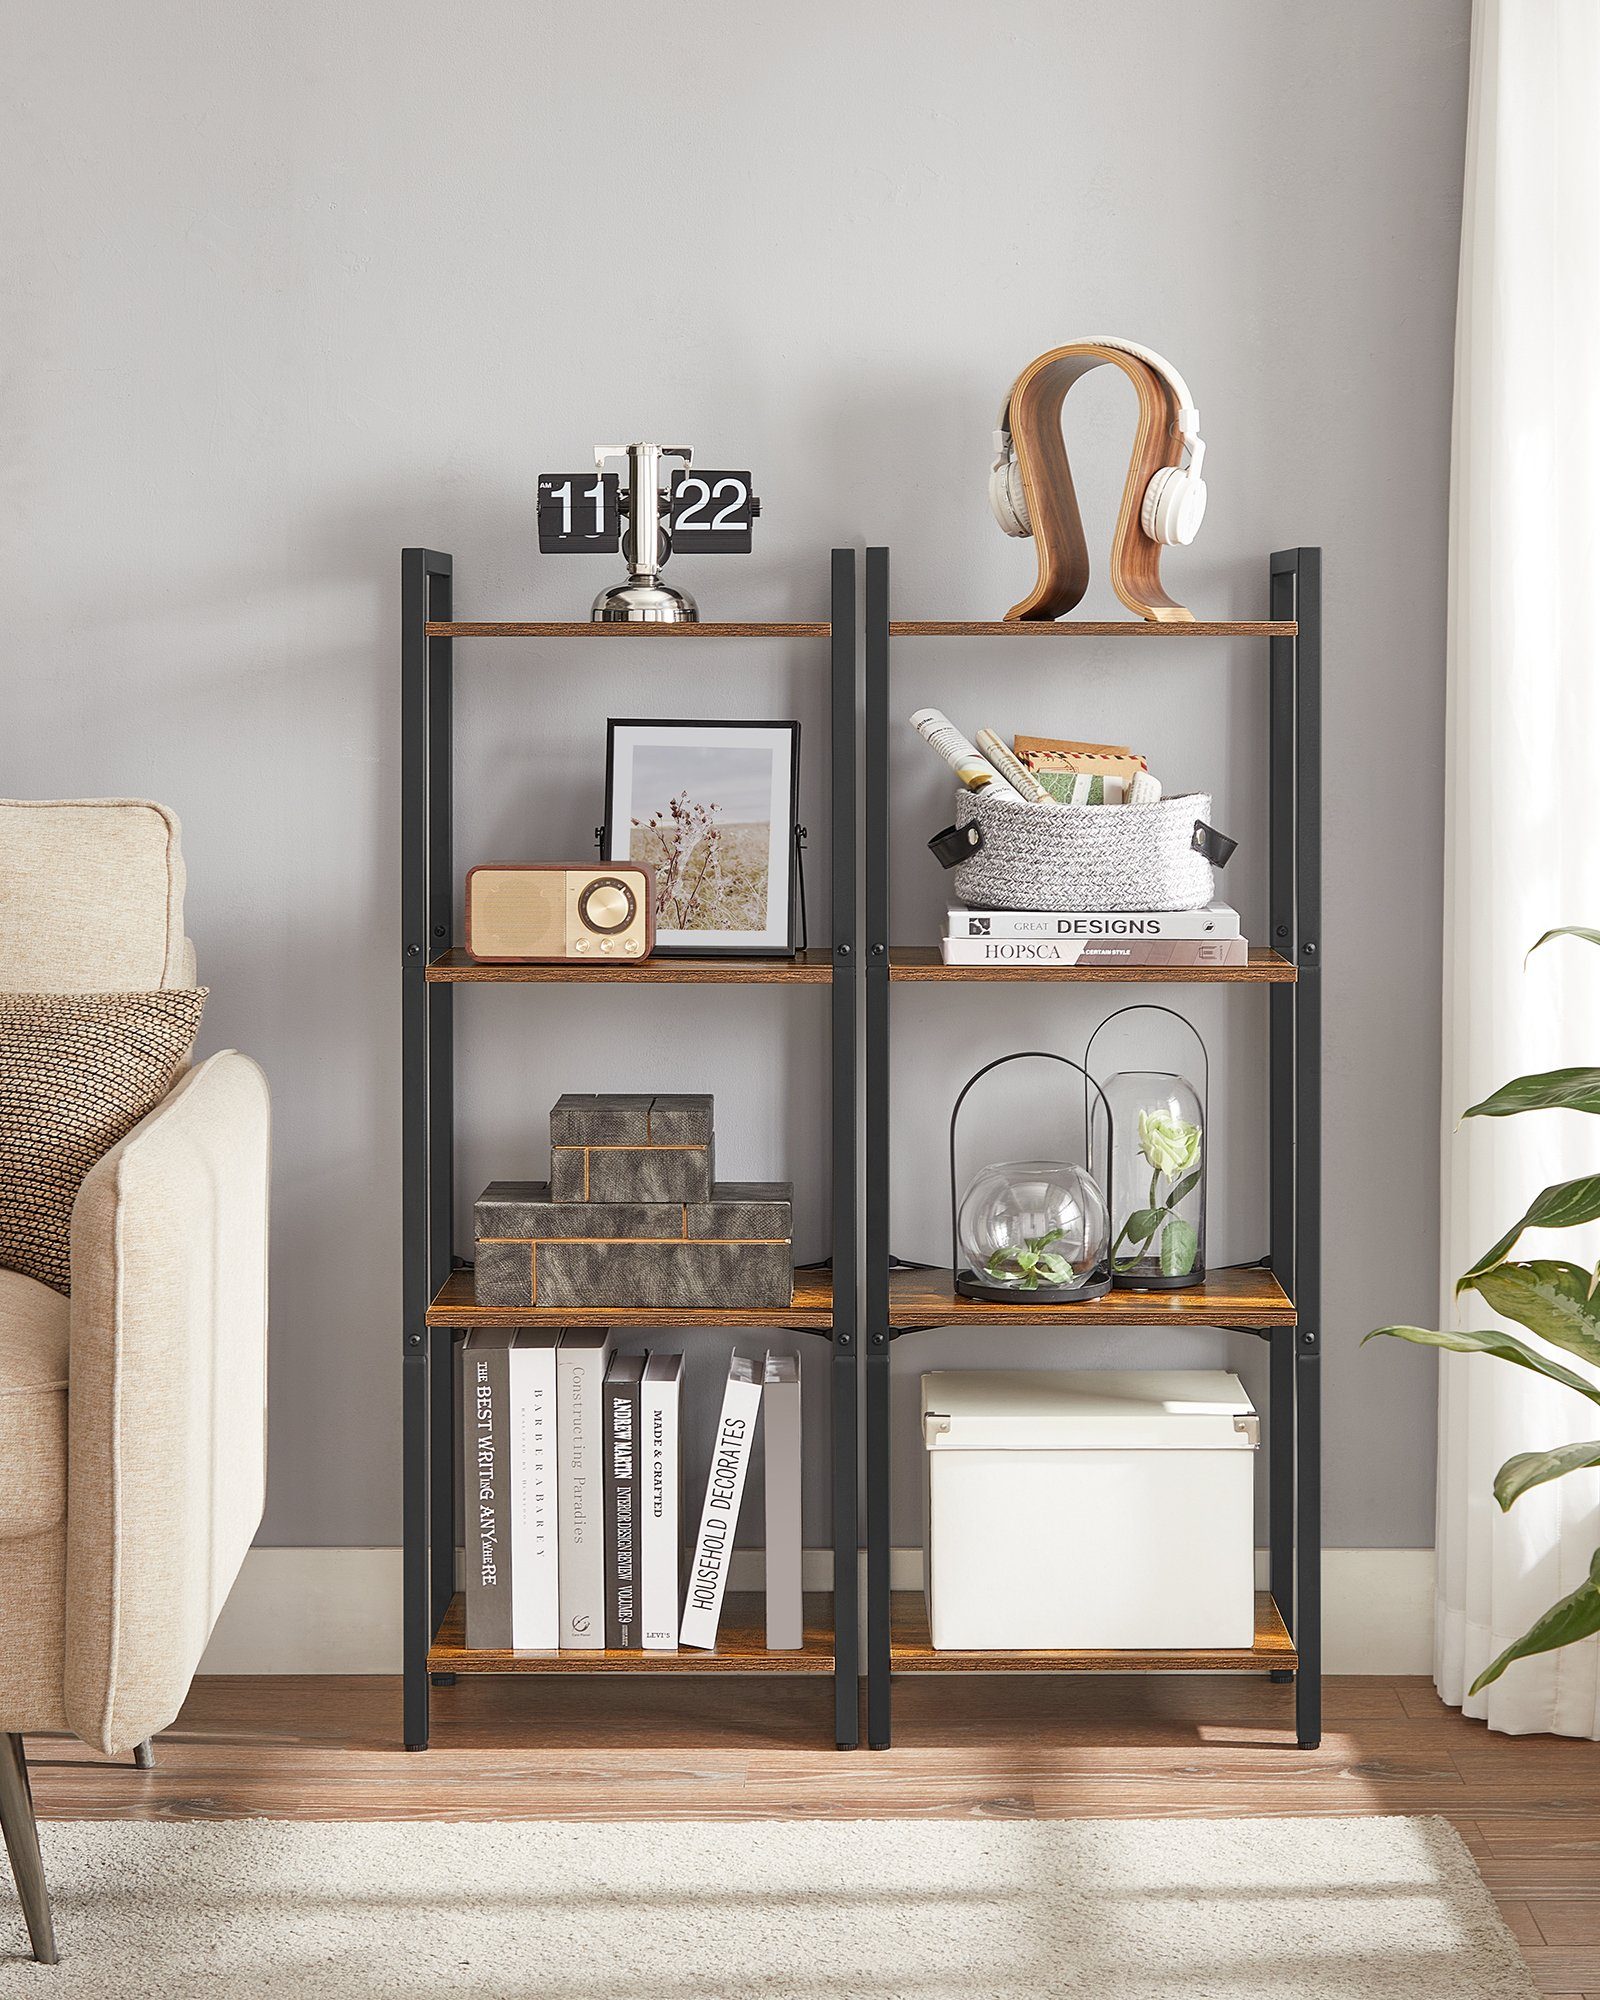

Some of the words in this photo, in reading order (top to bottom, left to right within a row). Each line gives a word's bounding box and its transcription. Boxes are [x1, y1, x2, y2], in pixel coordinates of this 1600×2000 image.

[550, 481, 605, 533] 11
[674, 478, 748, 531] 22
[1014, 922, 1049, 931] GREAT
[1057, 919, 1161, 934] DESIGNS
[985, 944, 1061, 960] HOPSCA
[477, 1361, 488, 1383] THE
[477, 1386, 493, 1432] BEST
[572, 1367, 585, 1469] Constructing
[613, 1397, 632, 1440] ANDREW
[653, 1410, 663, 1446] MADE
[478, 1434, 496, 1500] WRITING
[613, 1441, 633, 1479] MARTIN
[653, 1449, 663, 1459] &
[617, 1486, 632, 1522] INTERIOR
[653, 1461, 663, 1518] CRAFTED
[573, 1477, 586, 1544] Paradies
[691, 1518, 728, 1611] HOUSEHOLD
[710, 1417, 746, 1511] DECORATES
[617, 1523, 632, 1550] DESIGN
[617, 1551, 633, 1581] REVIEW
[617, 1585, 633, 1618] VOLUME
